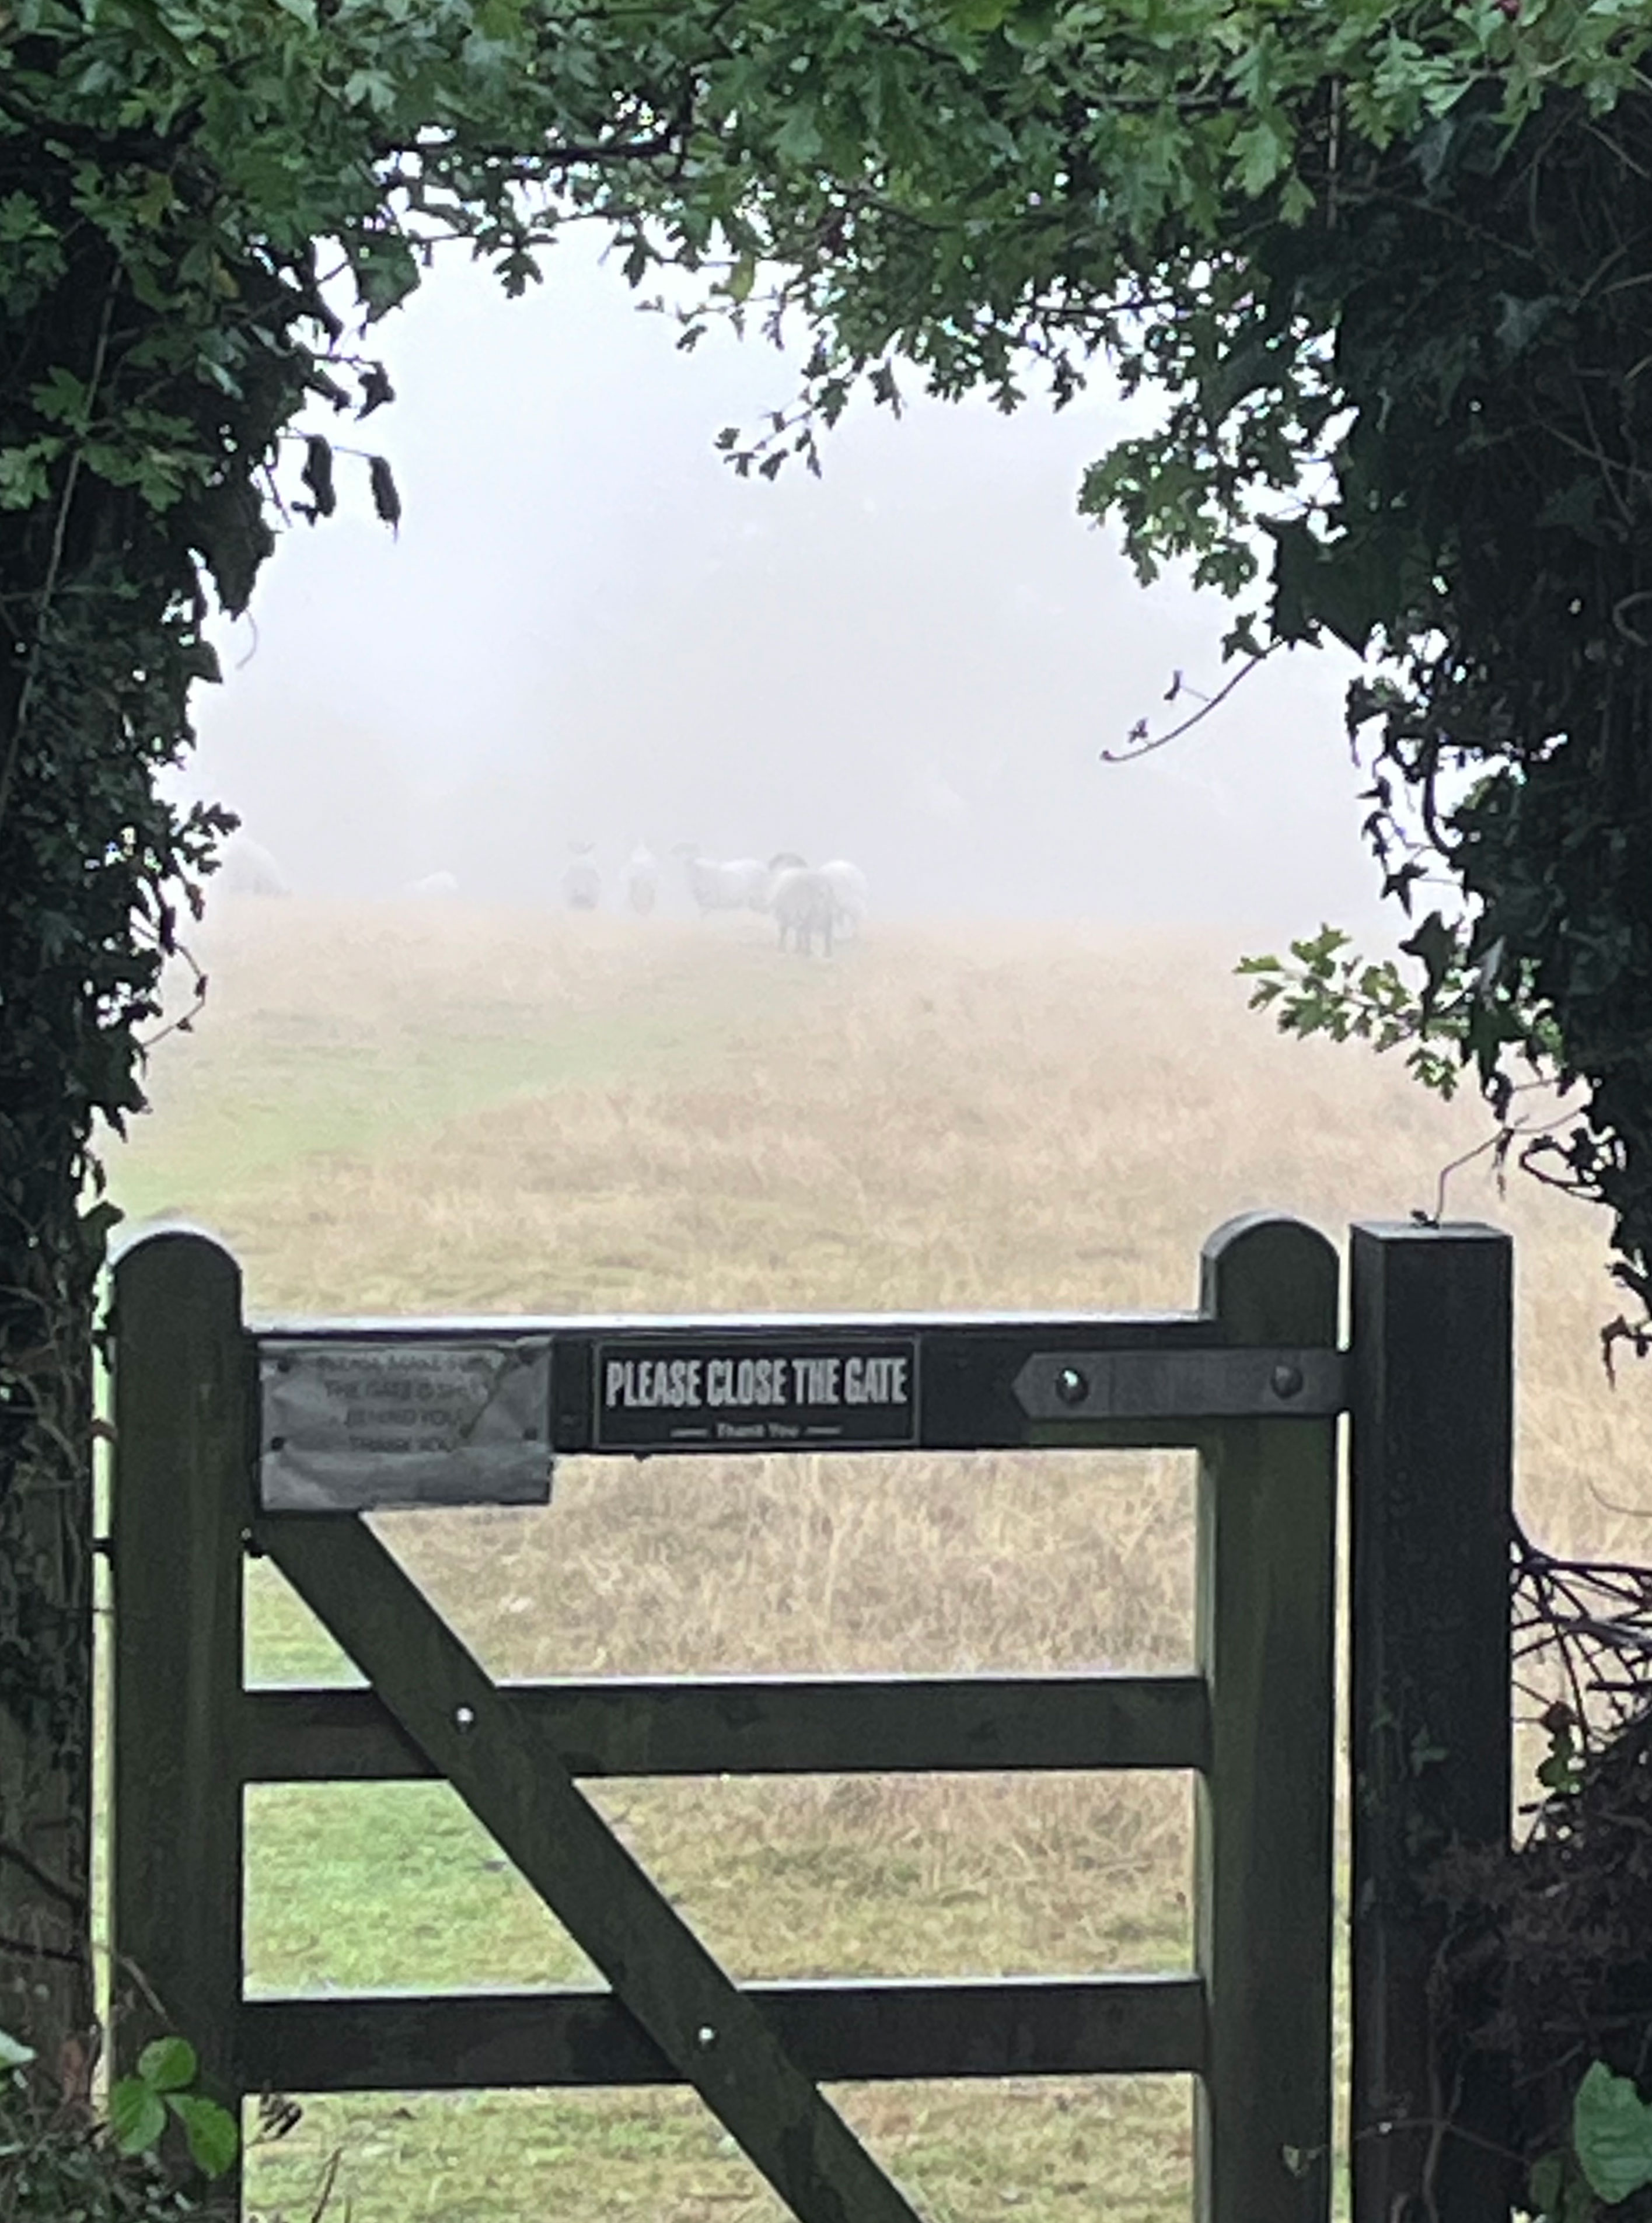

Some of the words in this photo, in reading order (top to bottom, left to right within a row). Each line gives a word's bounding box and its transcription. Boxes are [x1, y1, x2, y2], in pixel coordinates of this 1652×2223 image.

[606, 1359, 701, 1407] PLEASE
[707, 1358, 787, 1406] CLOSE
[792, 1358, 840, 1405] THE
[844, 1357, 907, 1404] GATE
